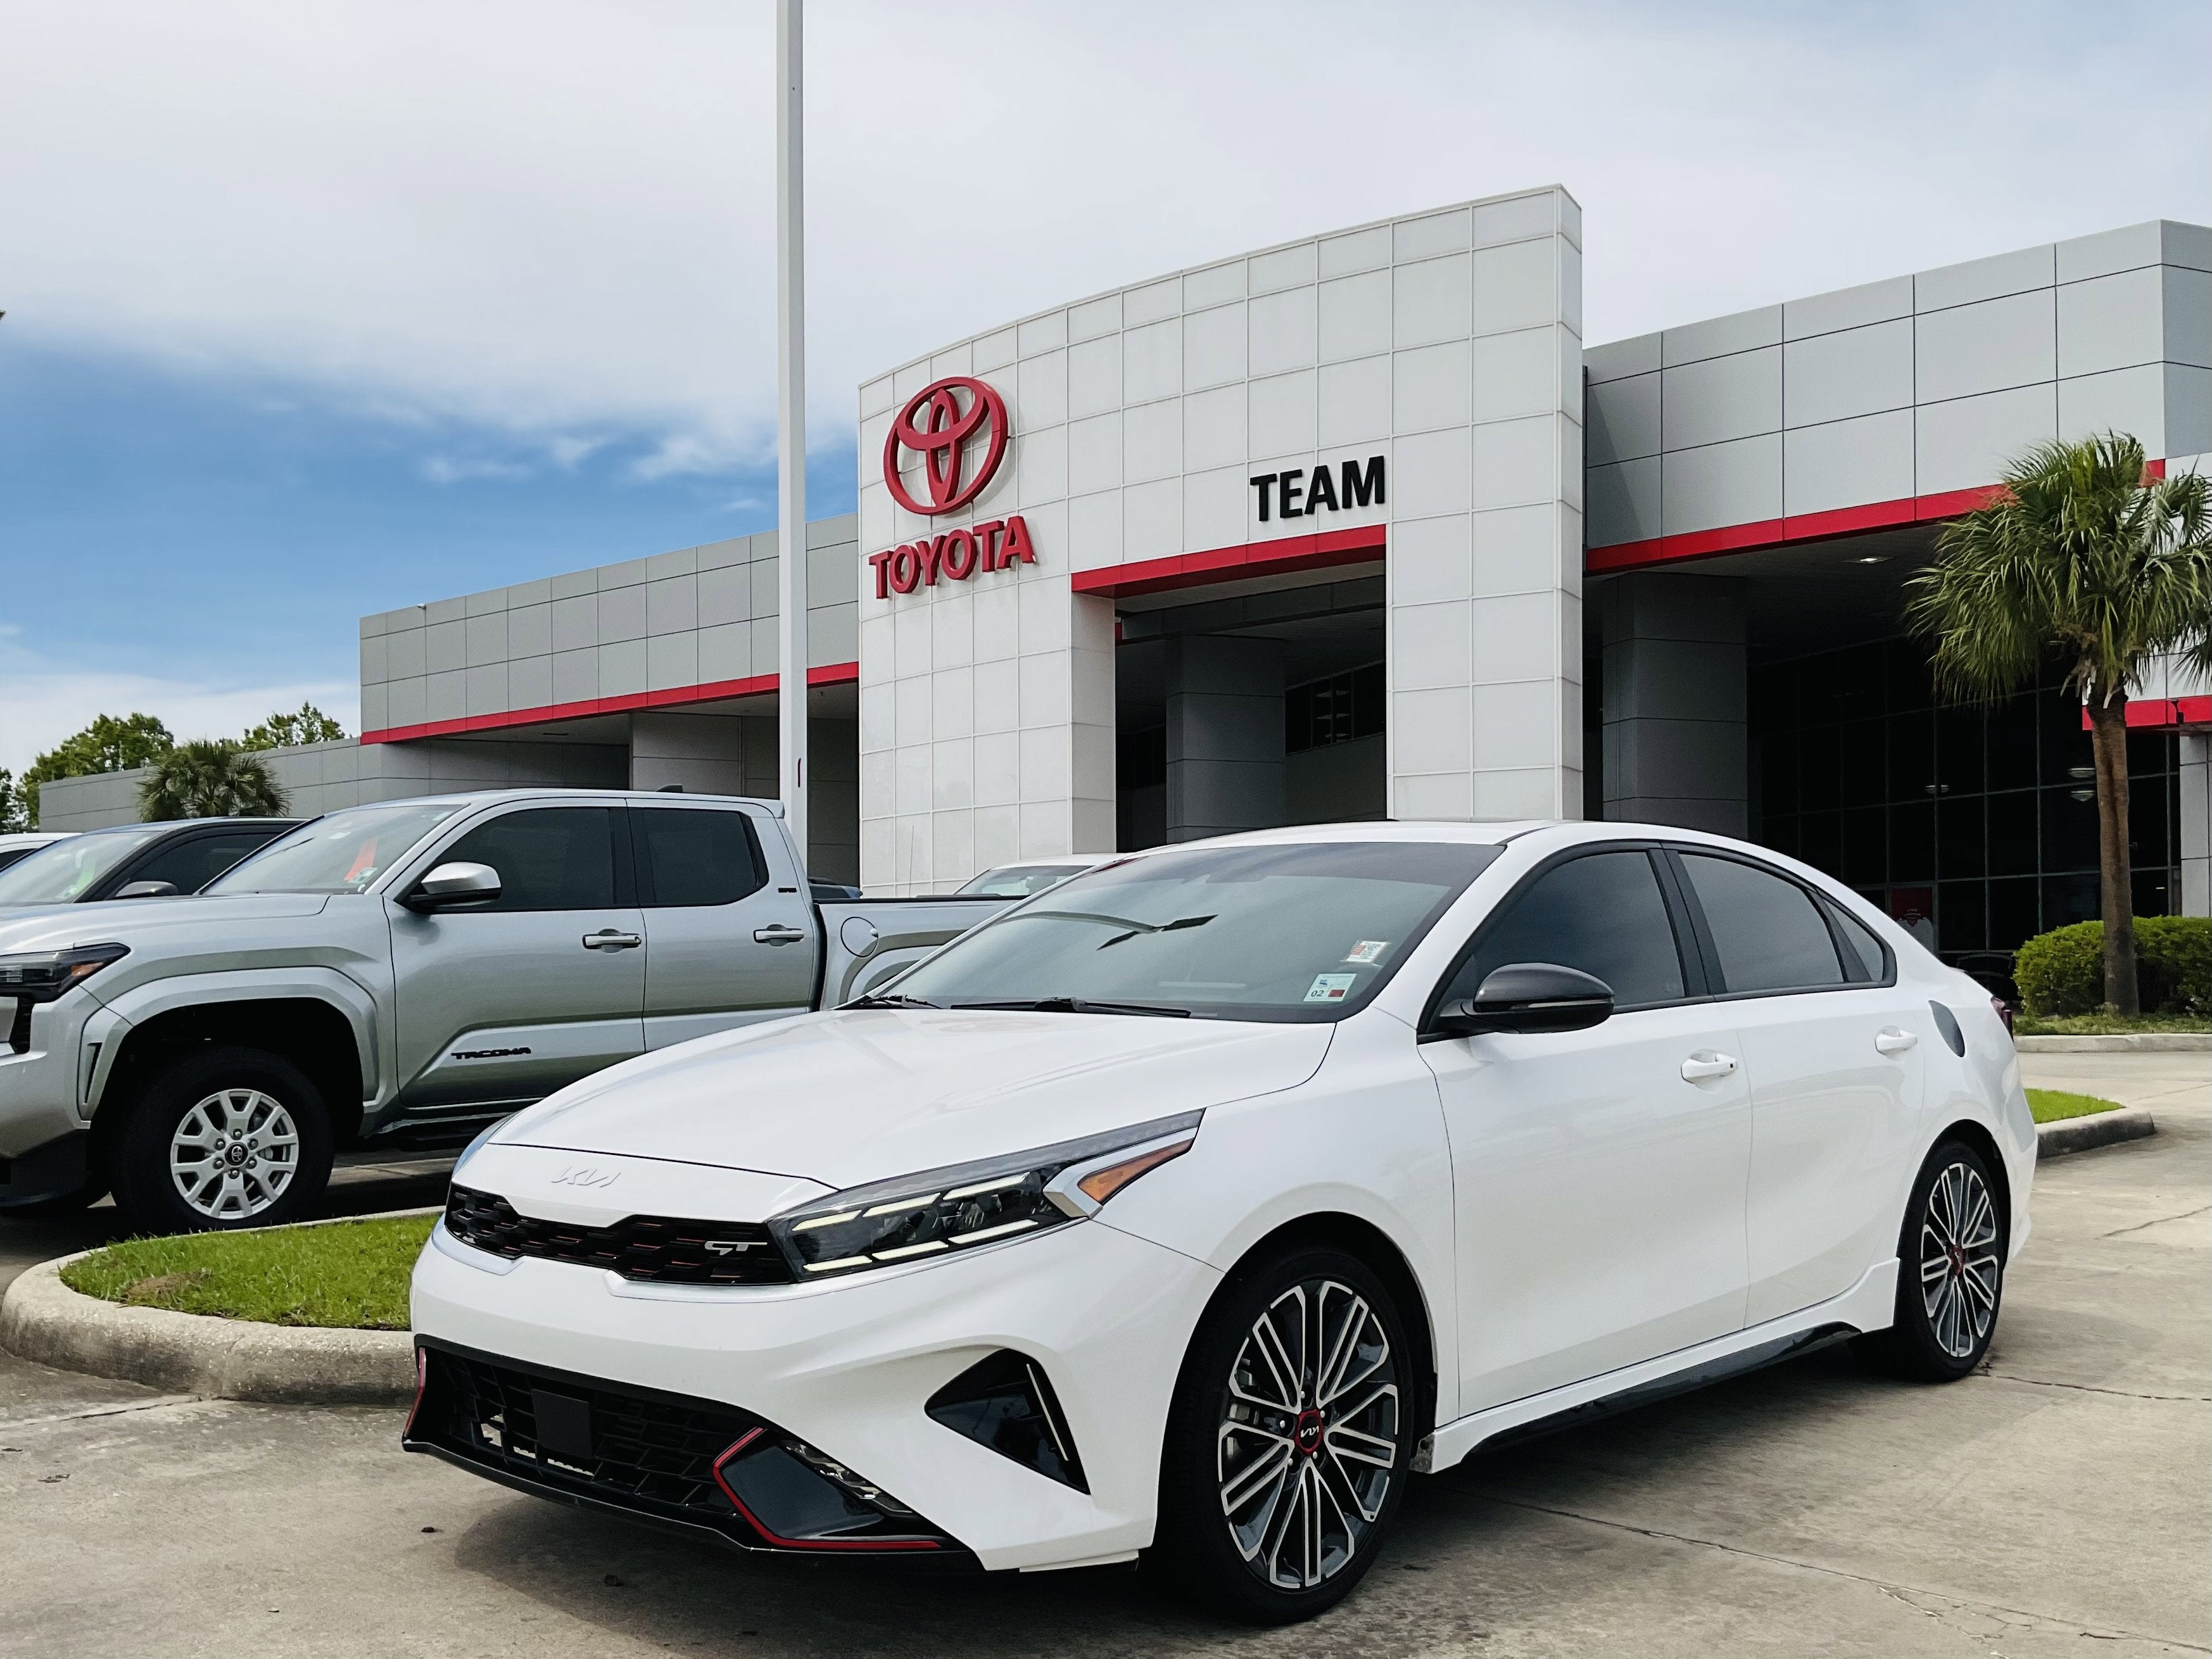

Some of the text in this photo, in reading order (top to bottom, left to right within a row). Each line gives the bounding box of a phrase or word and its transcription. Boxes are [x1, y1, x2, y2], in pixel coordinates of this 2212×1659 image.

[1250, 455, 1385, 522] TEAM
[869, 515, 1036, 599] TOYOTA
[704, 1240, 768, 1256] GT
